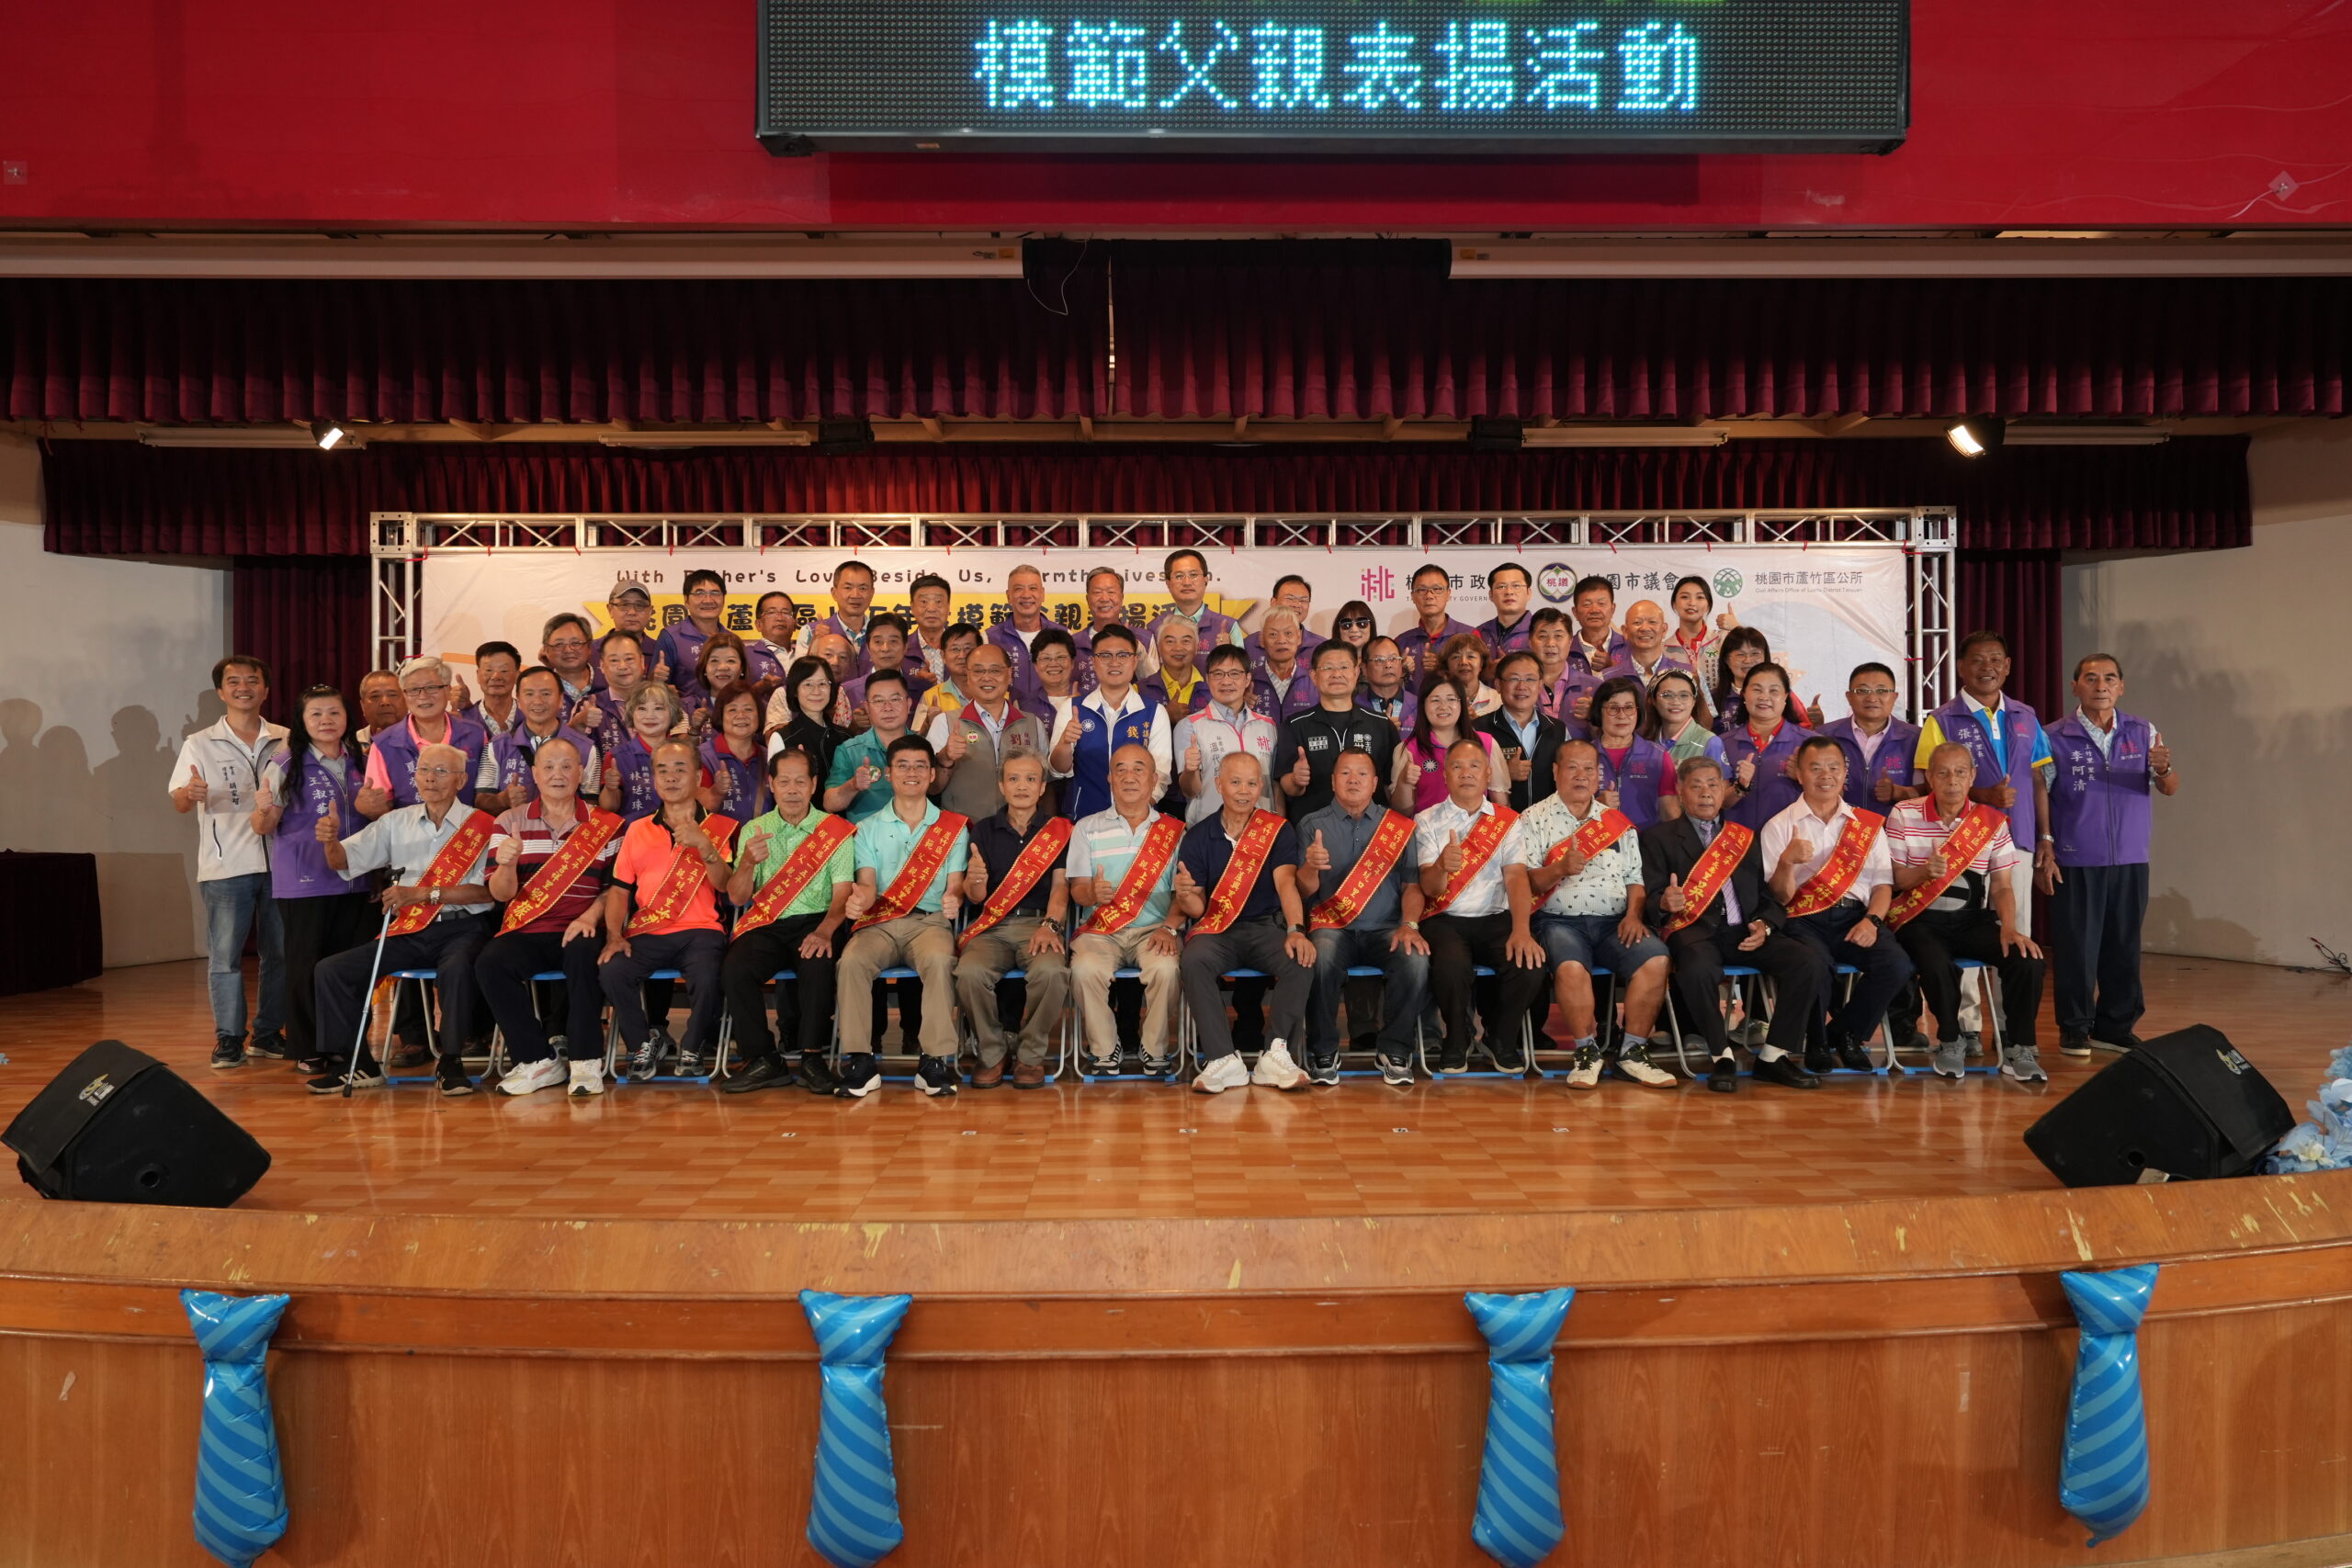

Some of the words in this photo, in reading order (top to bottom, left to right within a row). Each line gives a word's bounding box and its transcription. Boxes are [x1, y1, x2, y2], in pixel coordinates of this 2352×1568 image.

[974, 19, 1700, 111] 模範父親表揚活動
[616, 570, 664, 583] With
[796, 570, 834, 582] Lov
[958, 570, 992, 583] Us,
[1124, 569, 1166, 582] ives
[1587, 571, 1680, 591] 園市議會
[1755, 571, 1862, 585] 桃園市蘆竹區公所
[2070, 750, 2087, 792] 李阿清
[629, 771, 644, 811] 林延珠
